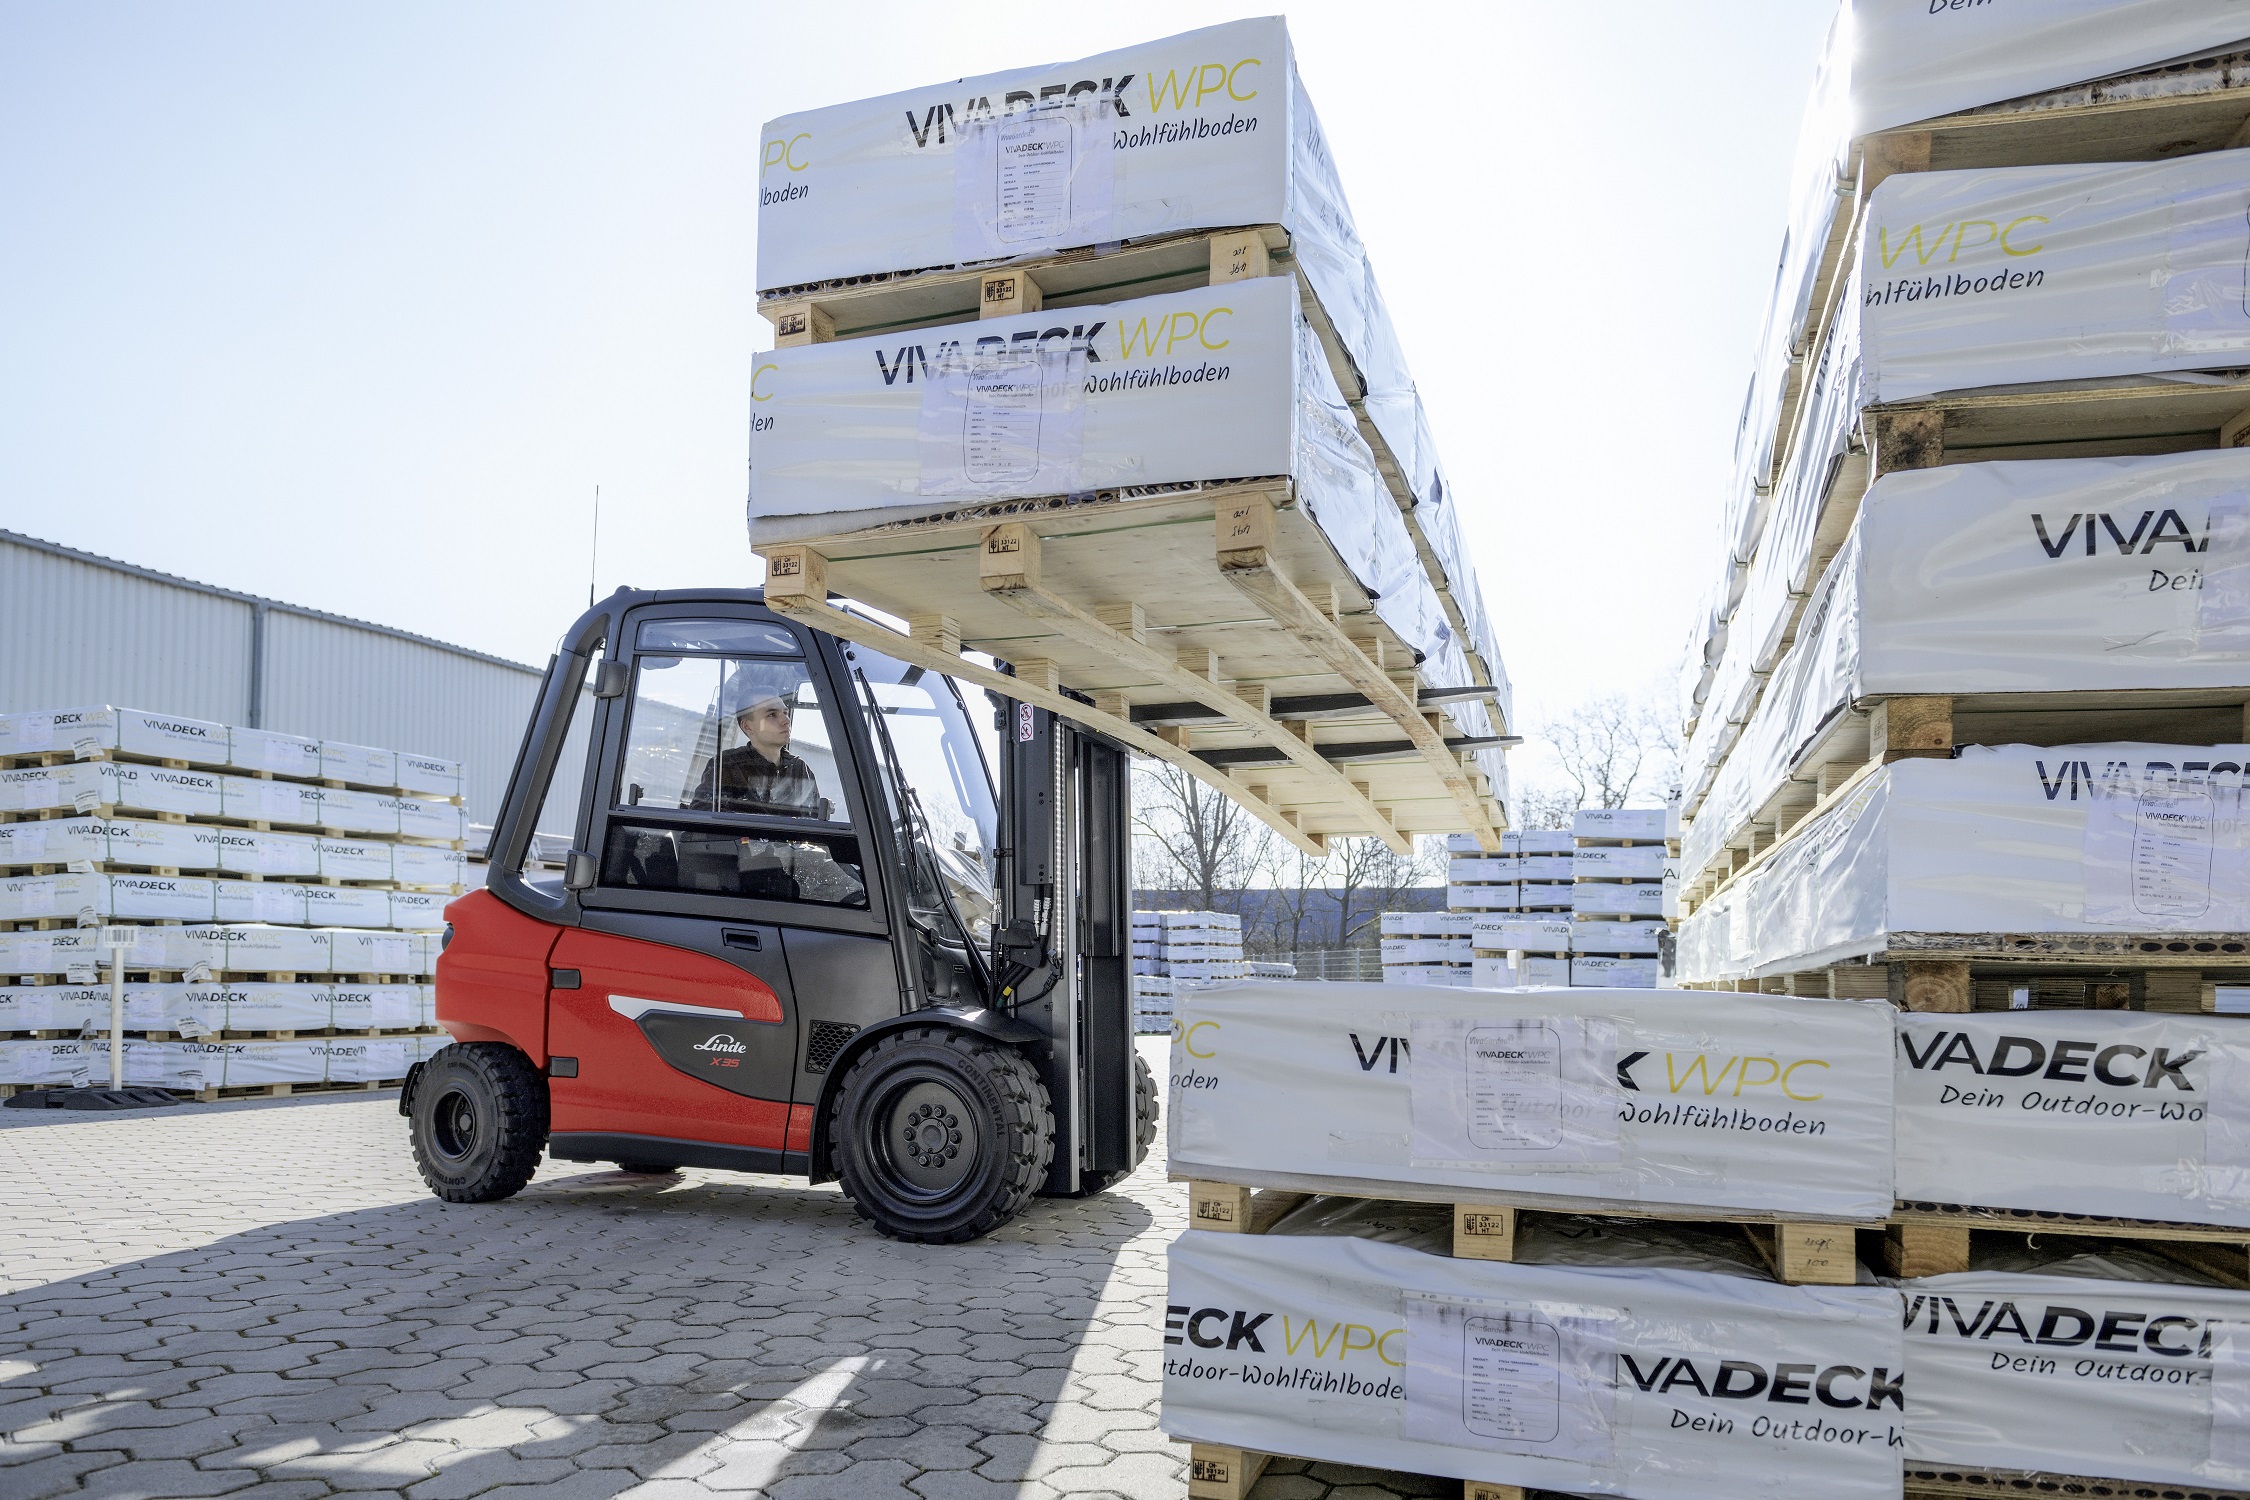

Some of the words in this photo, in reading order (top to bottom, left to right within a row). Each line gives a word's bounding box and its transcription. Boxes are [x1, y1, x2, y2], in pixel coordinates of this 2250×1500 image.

[1147, 58, 1262, 114] WPC
[760, 133, 812, 178] PC
[1880, 215, 2050, 270] WPC
[1118, 306, 1234, 360] WPC
[752, 363, 779, 402] C
[2031, 508, 2210, 559] VIVA
[54, 713, 83, 724] DECK
[143, 719, 207, 737] VIVADECK
[406, 759, 446, 773] VIVADECK
[151, 772, 213, 788] VIVADECK
[2035, 760, 2250, 801] VIVADEC
[67, 825, 131, 837] VIVADECK
[194, 834, 256, 847] VIVADECK
[312, 844, 365, 856] VVADECK
[185, 930, 247, 941] VIVADECK
[185, 992, 248, 1002] VIVADECK
[693, 1033, 747, 1054] Linde
[1476, 1050, 1524, 1059] VIVADECK
[1665, 1052, 1832, 1102] WPC
[957, 1058, 1005, 1139] CONTINENTAL
[1940, 1084, 2004, 1109] Dein
[1210, 1206, 1230, 1214] 33122
[1475, 1337, 1524, 1349] VIVADECK
[1991, 1351, 2056, 1374] Dein
[1162, 1358, 1407, 1400] tdoor-Wohlfühlbode
[1670, 1408, 1734, 1435] Dein
